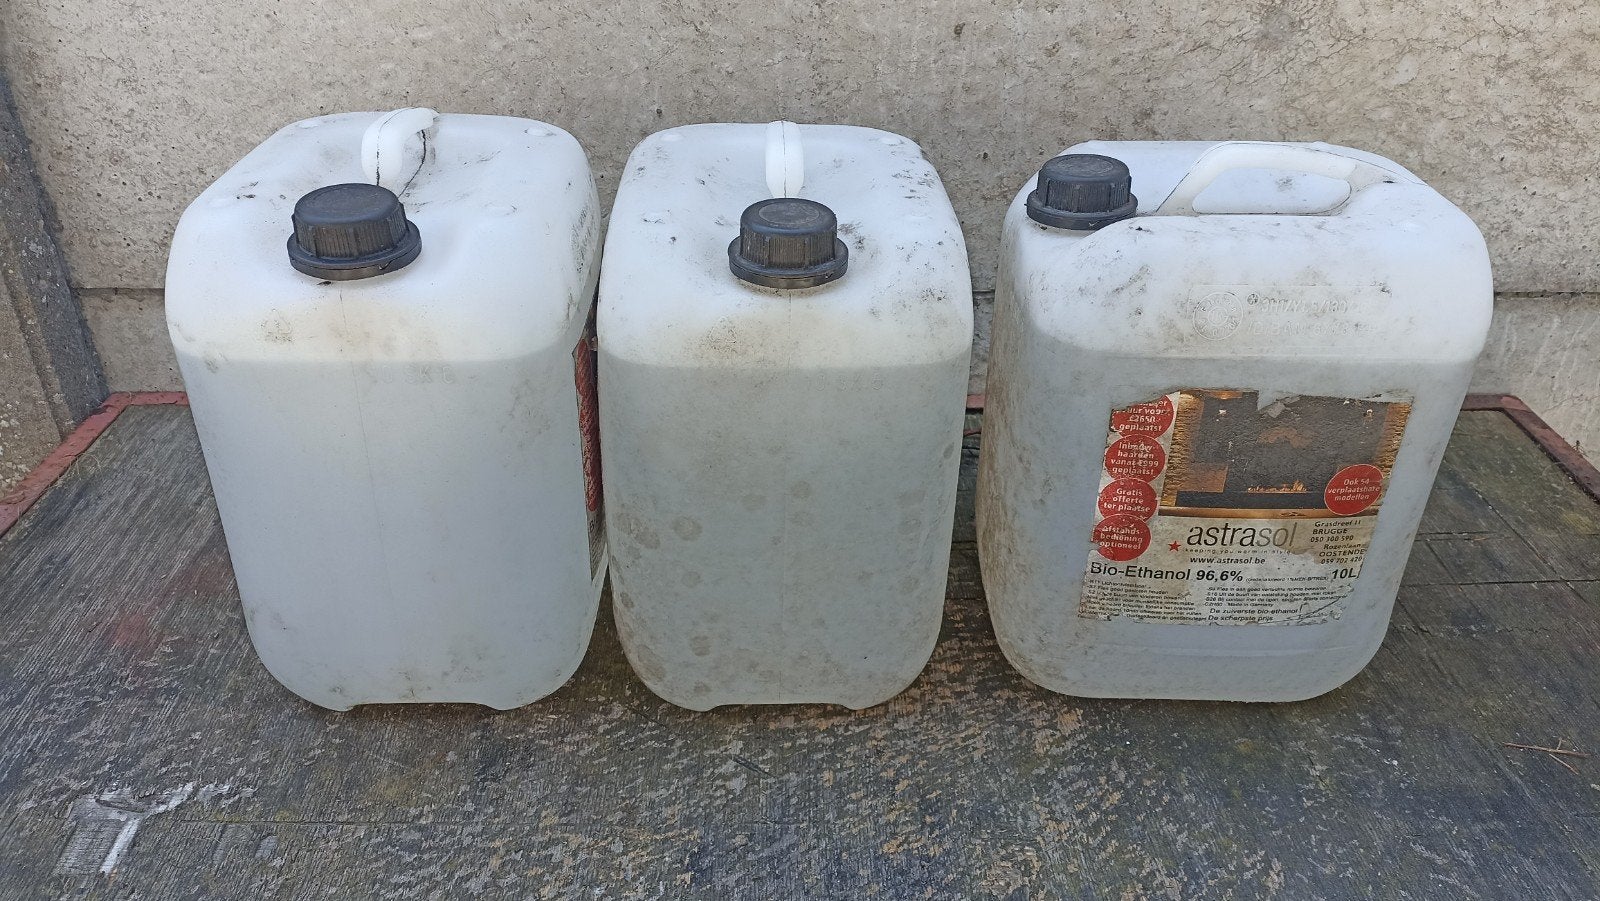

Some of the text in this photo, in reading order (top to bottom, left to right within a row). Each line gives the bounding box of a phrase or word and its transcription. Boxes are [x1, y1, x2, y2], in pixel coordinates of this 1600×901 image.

[1119, 424, 1161, 432] geplaatst
[1117, 450, 1154, 458] haarden
[1112, 467, 1154, 476] geplaatst
[1343, 478, 1359, 486] Ook
[1116, 488, 1143, 496] Gratis
[1113, 496, 1144, 504] offerte
[1118, 503, 1150, 512] plaatse
[1186, 522, 1298, 547] astrasol
[1100, 541, 1141, 550] optioneel
[1319, 549, 1366, 557] OOSTENDE
[1190, 557, 1266, 565] www.astrasol.be
[1090, 562, 1191, 580] Bio-Ethanol
[1196, 569, 1244, 583] 96,6%
[1332, 568, 1356, 579] 10L
